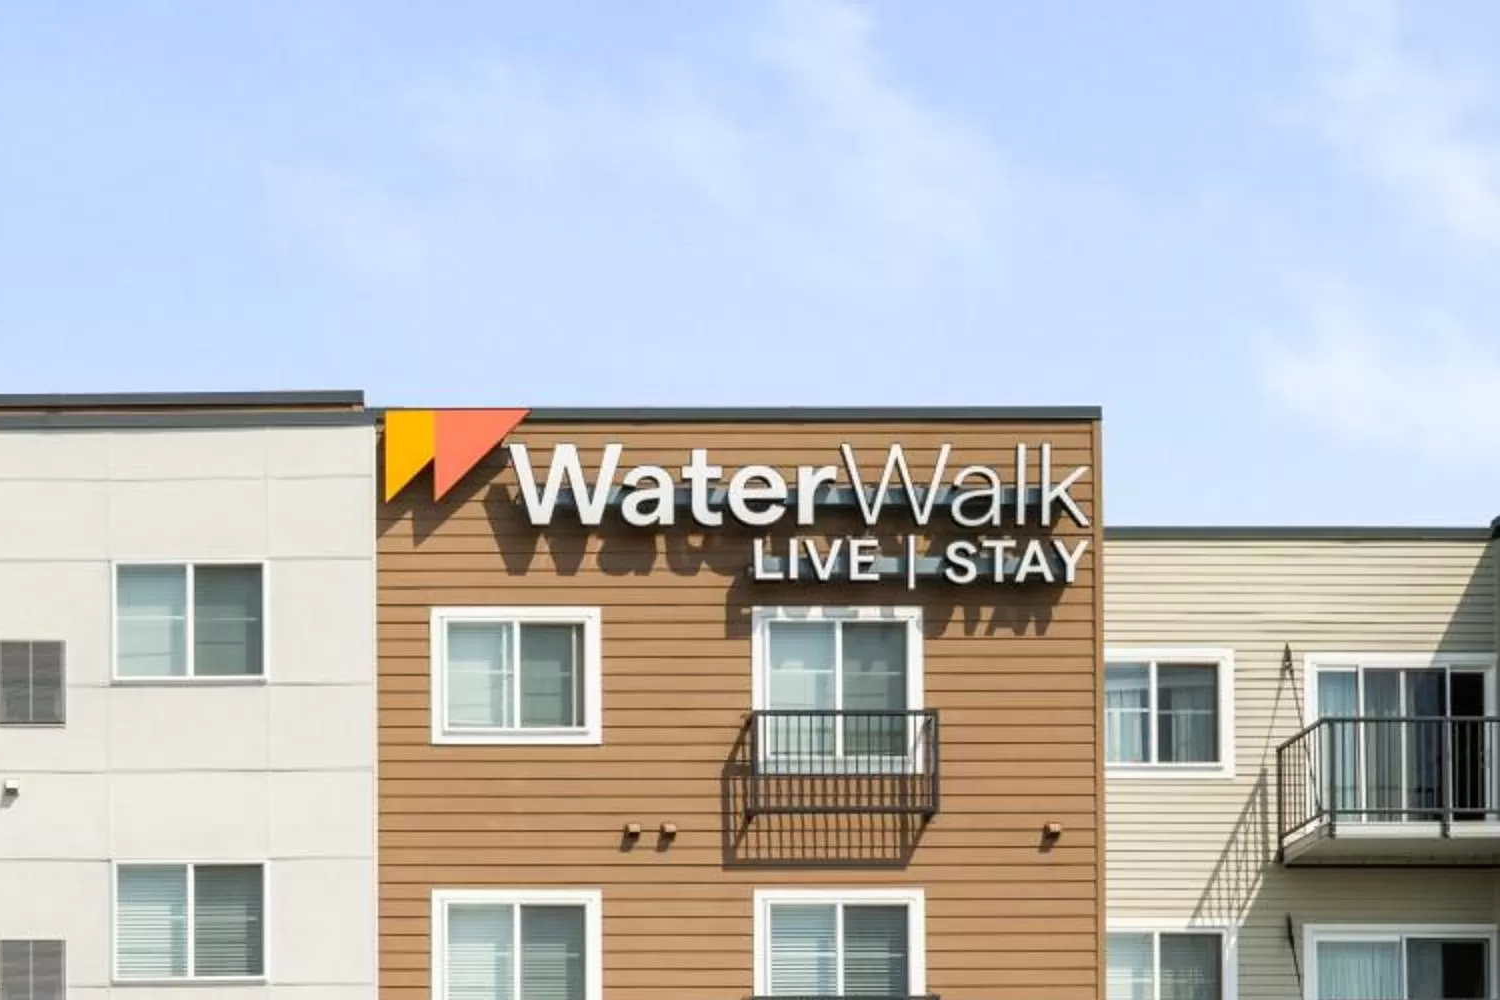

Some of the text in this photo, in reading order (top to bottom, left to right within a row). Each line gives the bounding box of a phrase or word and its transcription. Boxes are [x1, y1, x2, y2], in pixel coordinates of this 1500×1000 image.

[508, 443, 1090, 526] WaterWalk
[752, 538, 880, 582] LIVE
[944, 538, 1090, 584] STAY
